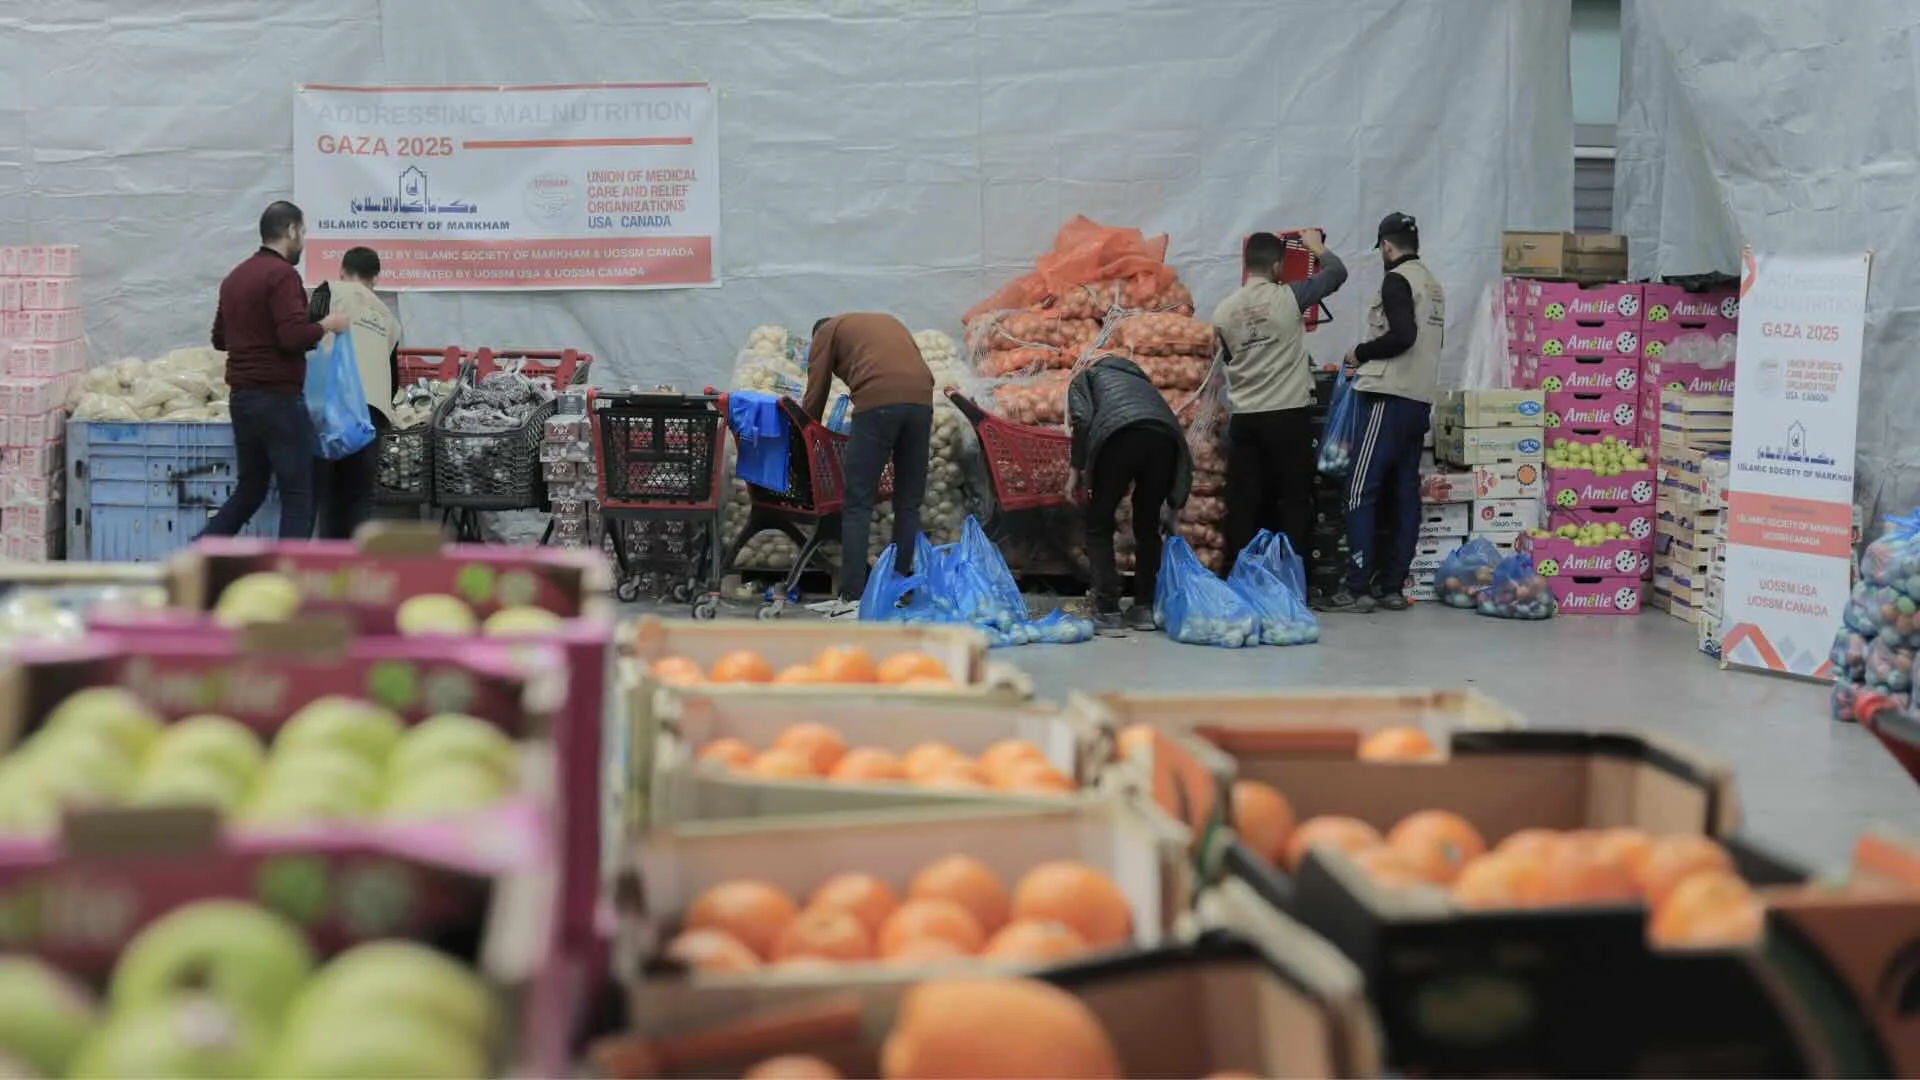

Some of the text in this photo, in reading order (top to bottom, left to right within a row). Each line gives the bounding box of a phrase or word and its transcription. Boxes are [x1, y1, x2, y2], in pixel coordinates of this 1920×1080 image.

[316, 101, 692, 126] ADDRESSING MALNUTRITION
[317, 134, 454, 157] GAZA 2025
[587, 169, 698, 184] UNION OF MEDICAL
[587, 184, 688, 198] CARE AND RELIEF
[587, 199, 686, 213] ORGANIZATIONS
[318, 220, 510, 230] ISLAMIC SOCIETY OF MARKHAM
[588, 215, 672, 229] USA CANADA
[396, 250, 411, 260] BY
[415, 251, 459, 261] ISLAMIC
[462, 250, 510, 261] SOCIETY
[513, 250, 529, 260] OF
[532, 249, 590, 260] MARKHAM
[649, 246, 695, 257] CANADA
[379, 269, 451, 280] MPLEMENTED
[455, 269, 470, 280] BY
[518, 268, 540, 279] USA
[598, 267, 645, 278] CANADA
[1568, 297, 1615, 314] Amélie
[1671, 300, 1718, 317] Amélie
[1762, 322, 1840, 341] GAZA 2025
[1566, 333, 1613, 350] Amélie
[1566, 370, 1613, 387] Amélie
[1564, 407, 1611, 423] Amélie
[1737, 463, 1767, 473] ISLAMIC
[1769, 465, 1801, 477] SOCIETY
[1803, 469, 1813, 478] OF
[1581, 483, 1628, 500] Amélie
[1562, 553, 1612, 570] Amélie
[1797, 583, 1818, 598] USA
[1562, 591, 1612, 608] Amélie
[1785, 599, 1828, 617] CANADA
